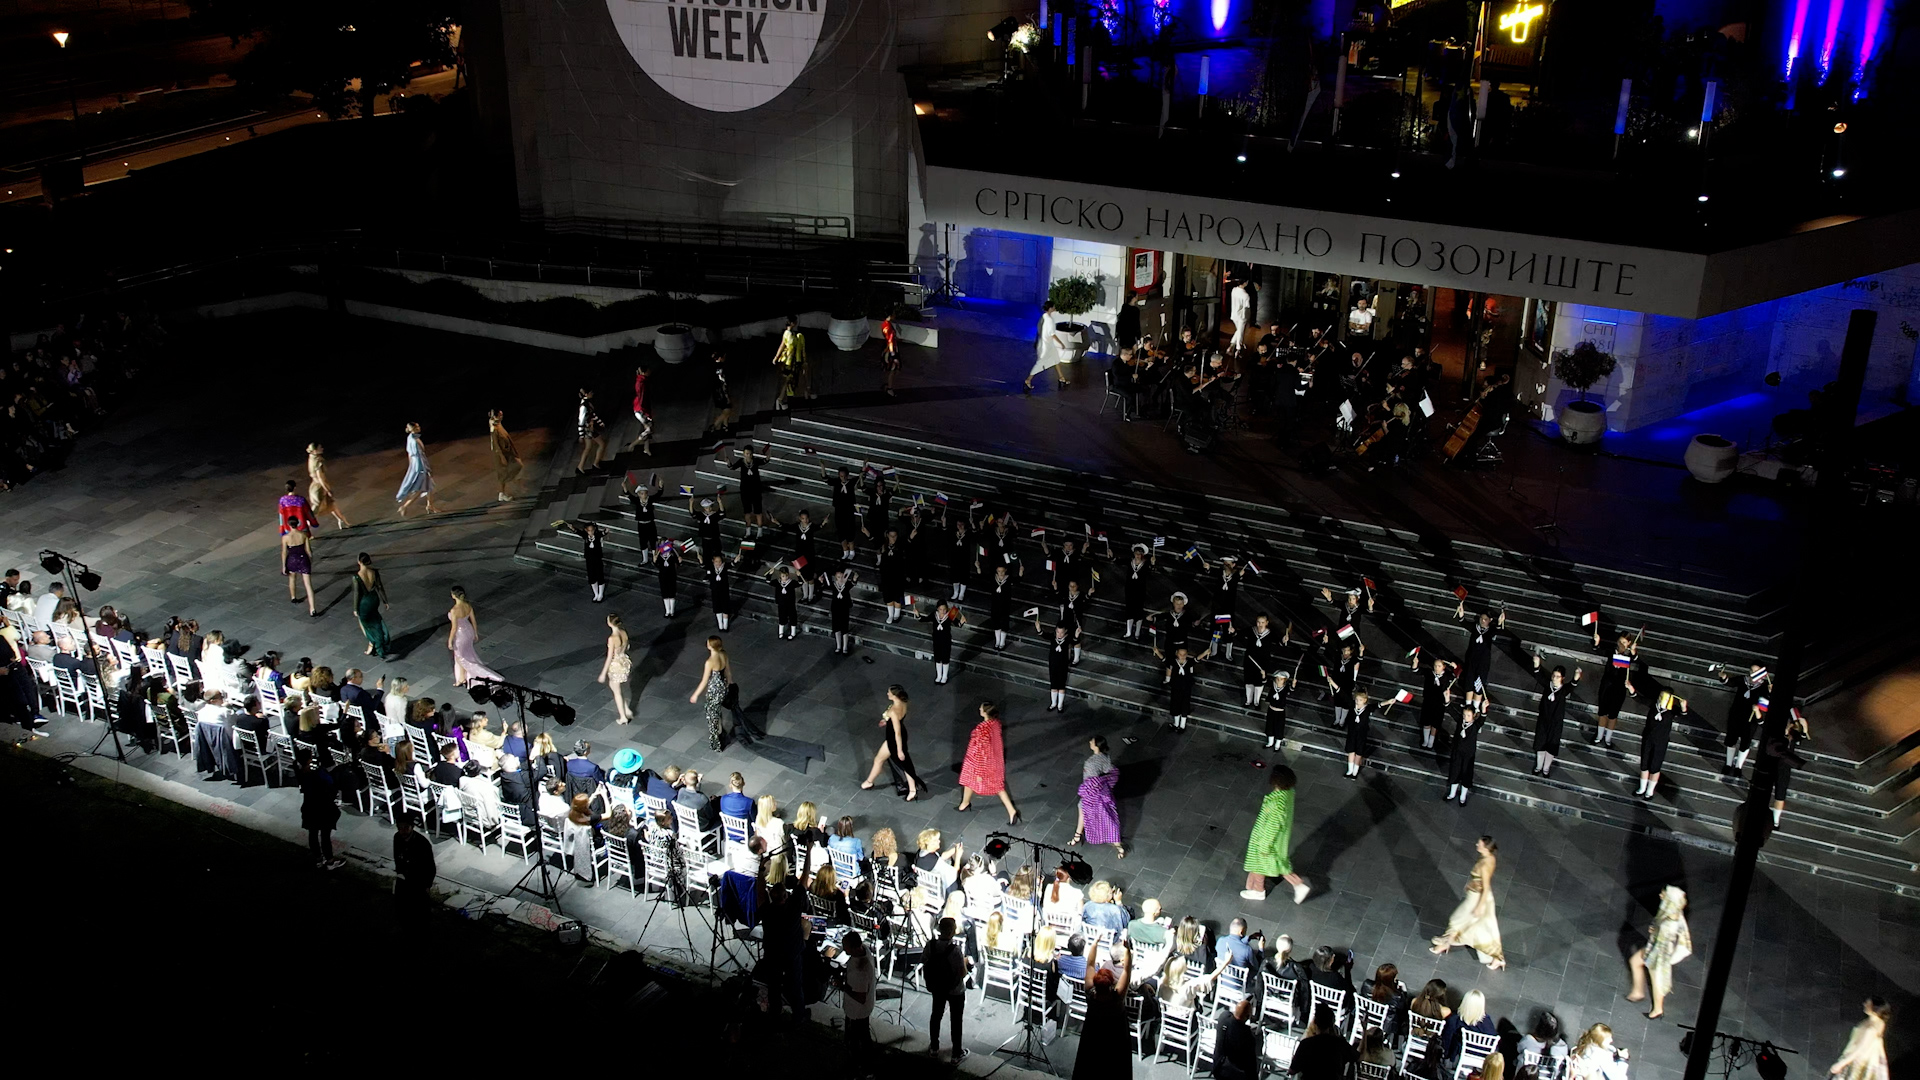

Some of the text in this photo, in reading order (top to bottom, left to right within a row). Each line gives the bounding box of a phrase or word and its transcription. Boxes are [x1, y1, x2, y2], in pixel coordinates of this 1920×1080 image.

[667, 6, 769, 64] WEEK
[975, 187, 1637, 297] СРПСКО НАРОДНО ПОЗОРИШТЕ
[1074, 256, 1097, 267] СНП
[1584, 324, 1614, 336] СНП
